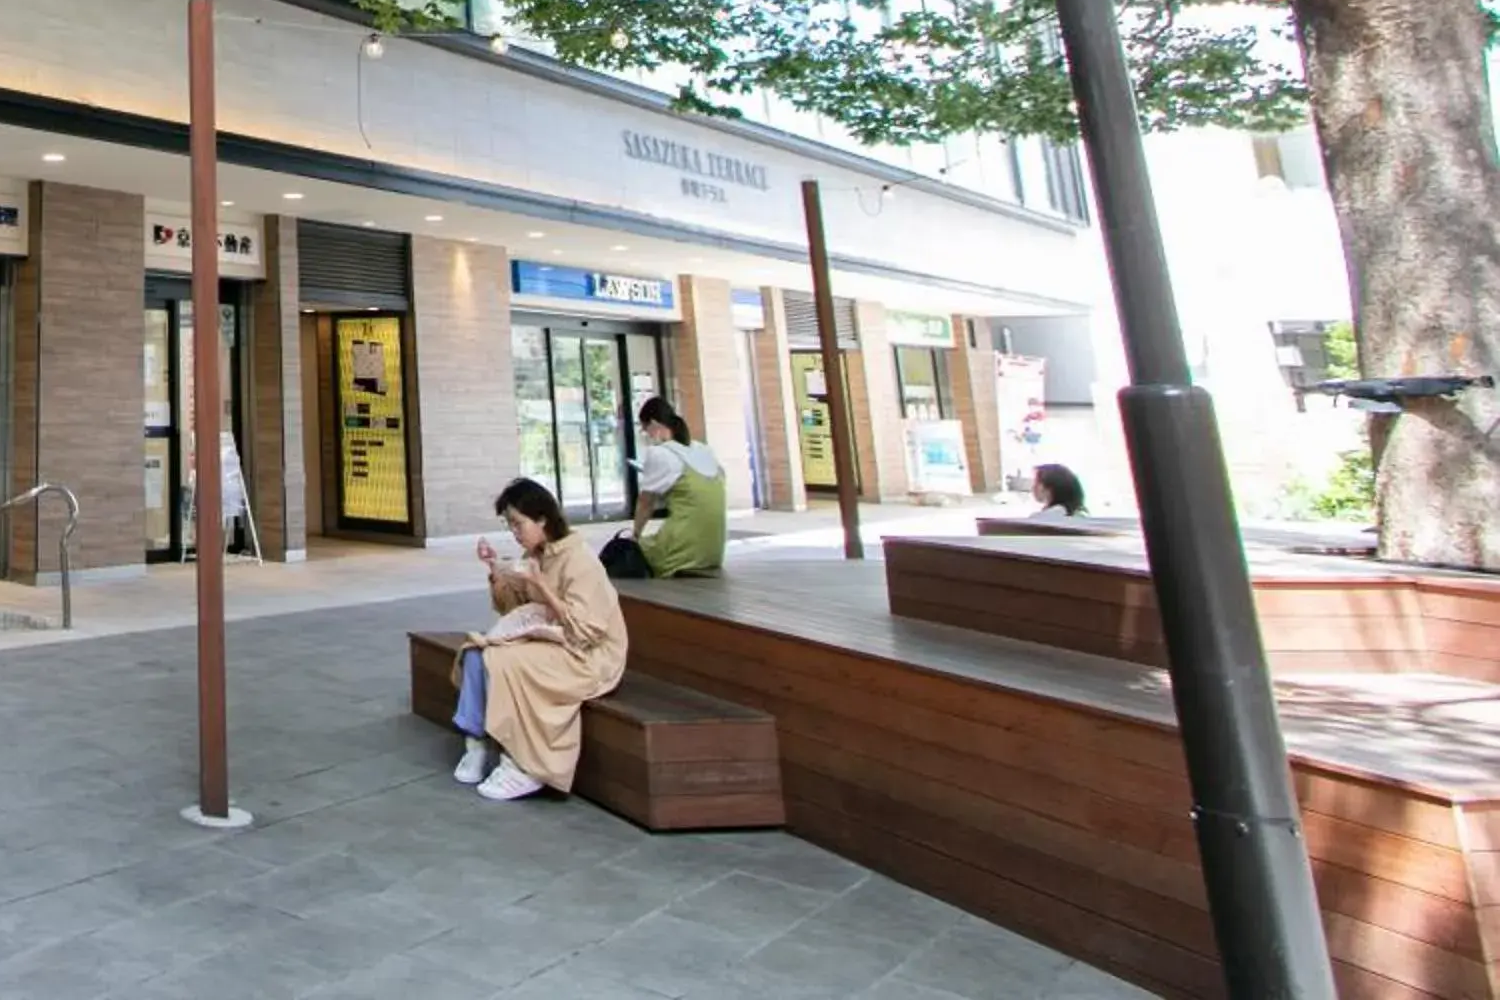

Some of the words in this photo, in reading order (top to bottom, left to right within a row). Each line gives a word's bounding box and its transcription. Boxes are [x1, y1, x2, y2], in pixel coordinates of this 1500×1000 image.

[176, 226, 252, 255] 京動産
[592, 272, 662, 304] LAWSON
